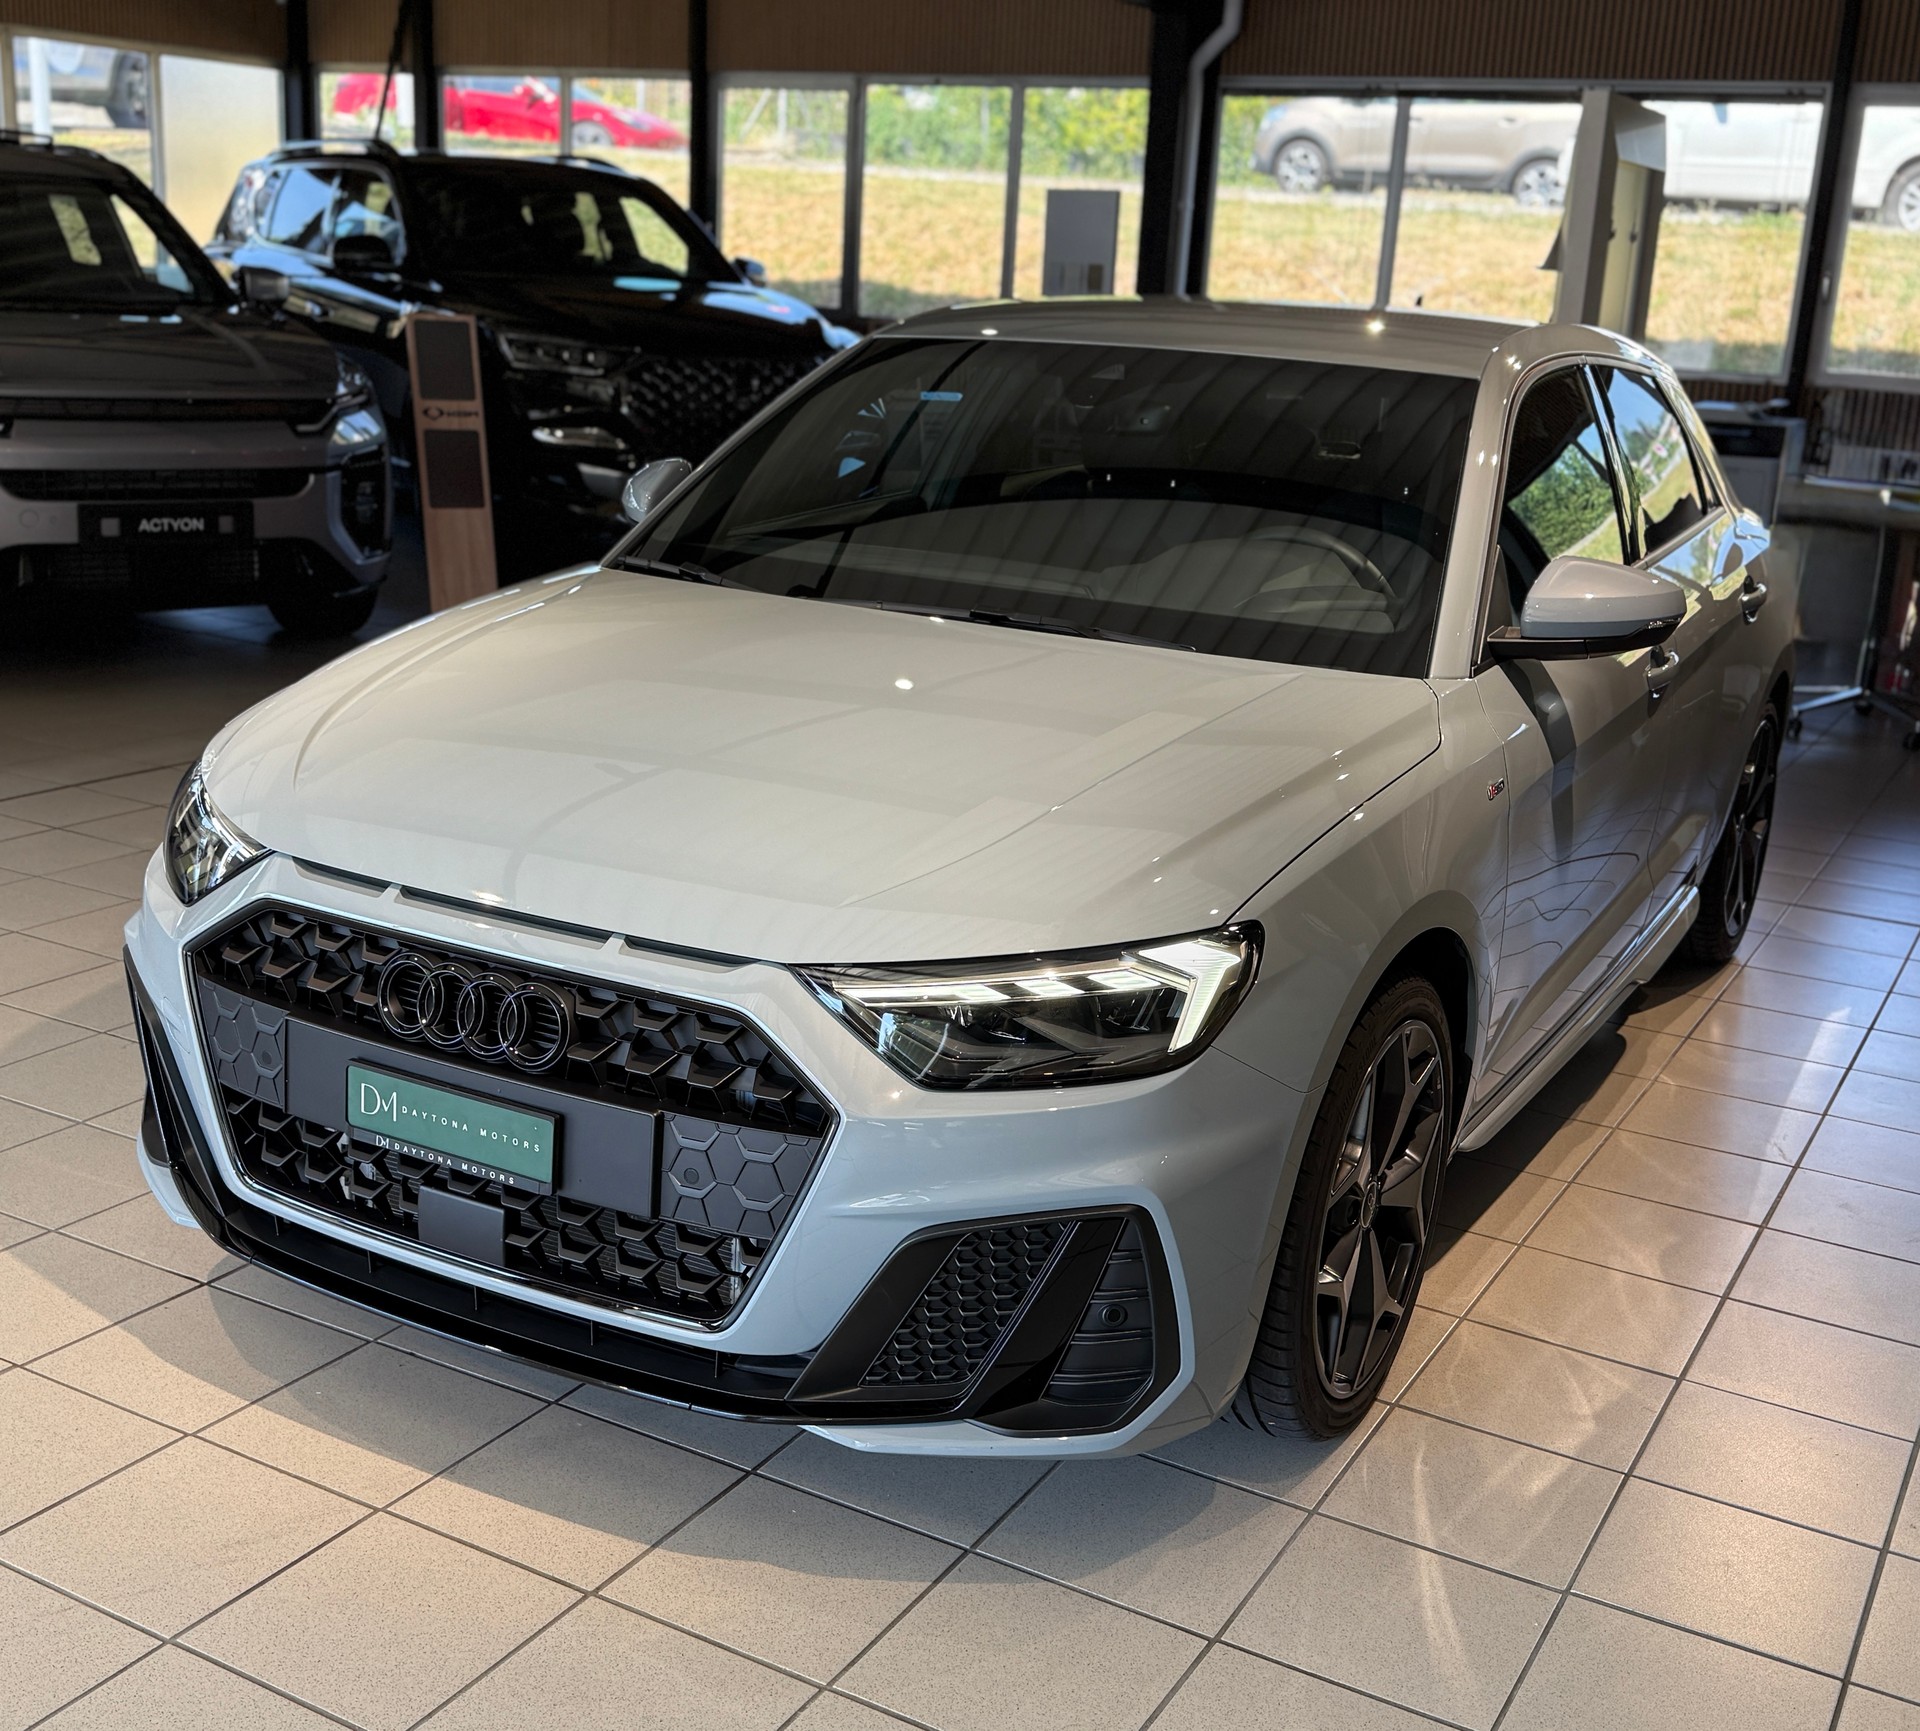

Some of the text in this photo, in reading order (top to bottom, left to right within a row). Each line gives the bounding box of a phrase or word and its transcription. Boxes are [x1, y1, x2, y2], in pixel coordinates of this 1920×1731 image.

[138, 517, 205, 533] ACTYON
[360, 1082, 541, 1153] DM DAYTONA MOTORS
[394, 1142, 452, 1166] DAYTONA
[461, 1162, 515, 1185] MOTORS
